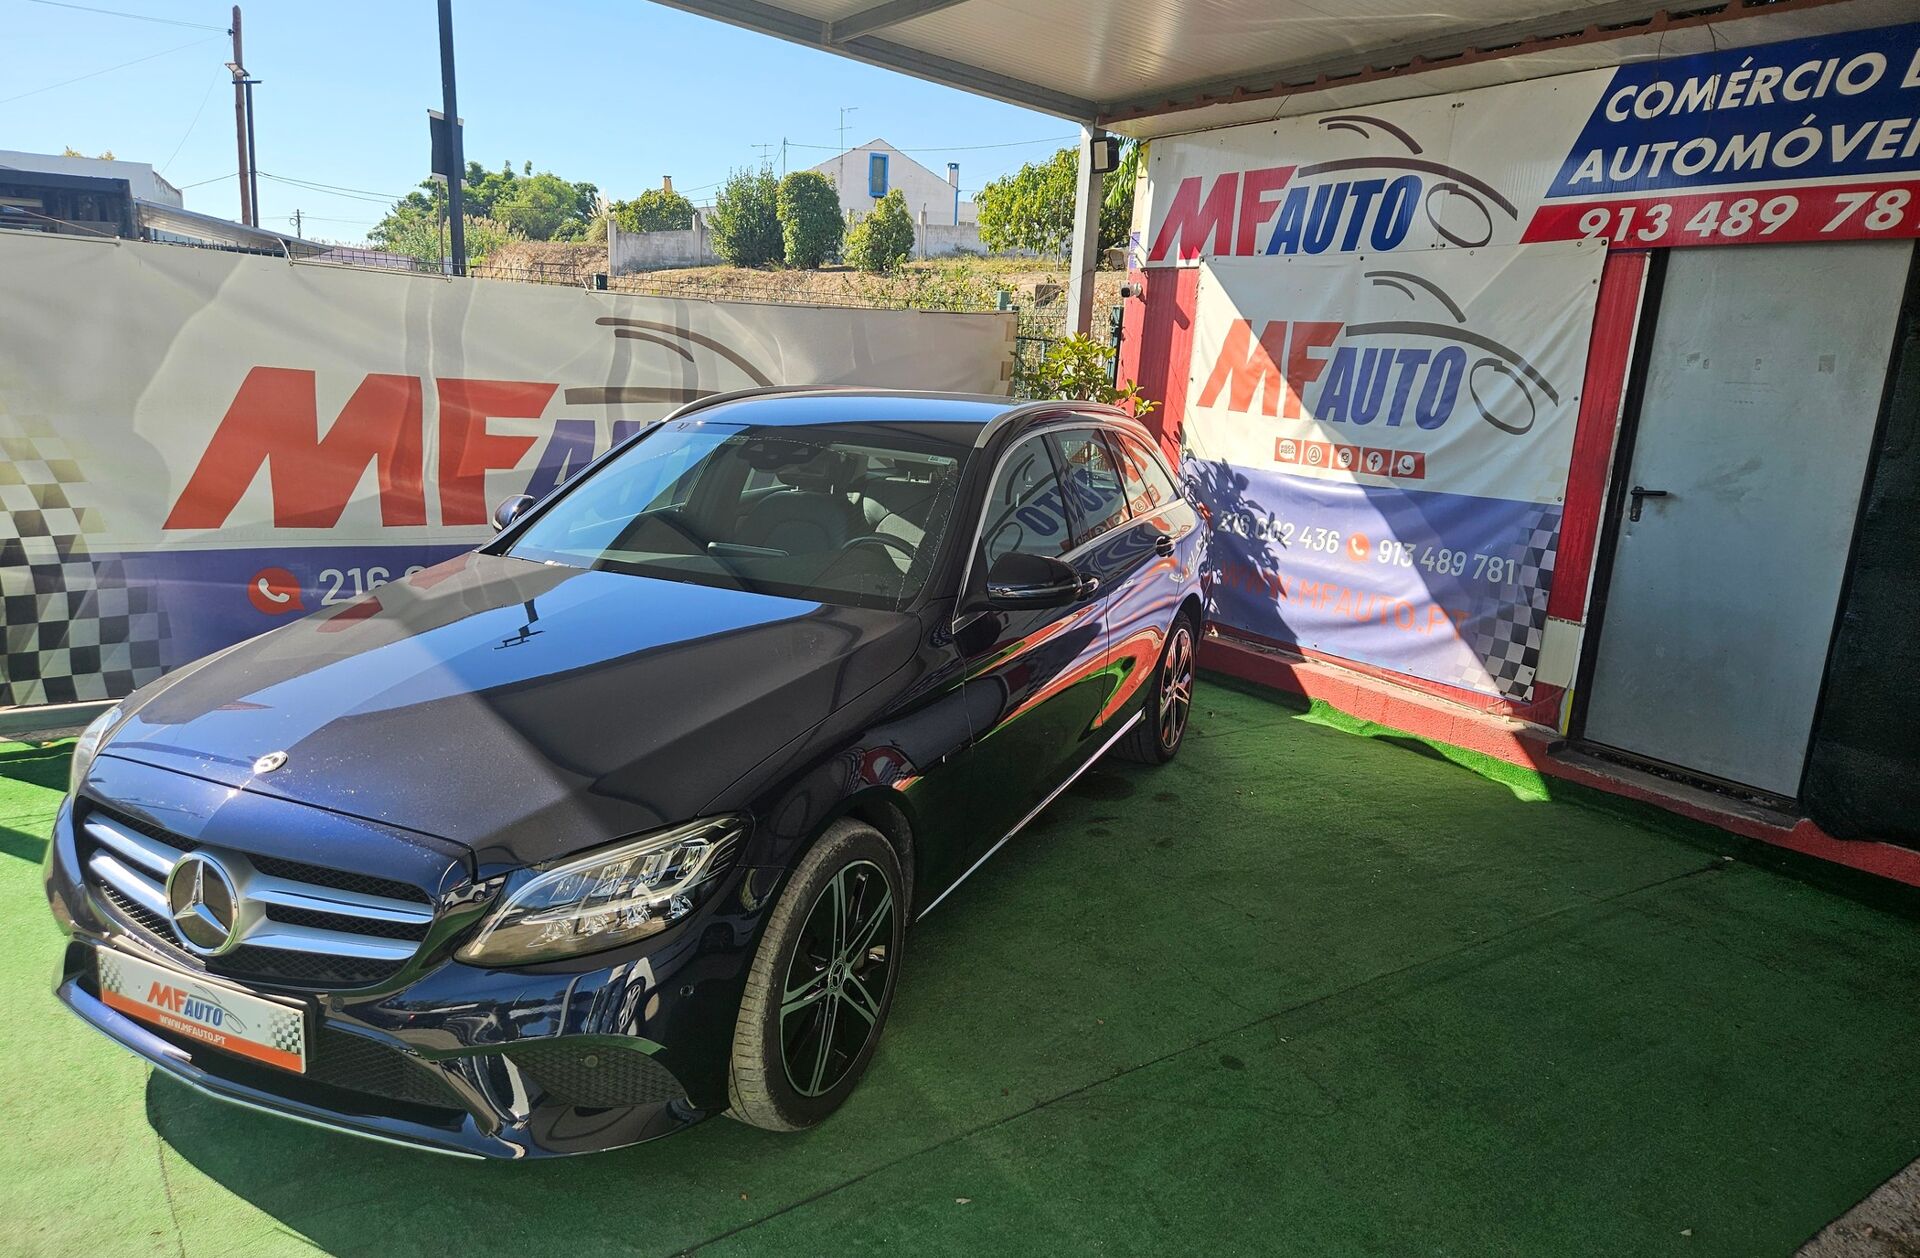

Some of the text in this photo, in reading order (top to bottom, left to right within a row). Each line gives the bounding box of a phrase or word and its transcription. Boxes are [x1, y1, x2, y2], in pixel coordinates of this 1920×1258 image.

[1605, 52, 1887, 122] COMÉRCIO
[1578, 188, 1920, 242] 913 489 78
[1299, 526, 1341, 553] 436
[1377, 539, 1417, 568] 913
[1420, 547, 1467, 577] 489
[1472, 553, 1515, 585] 781
[159, 1013, 226, 1046] WWW.MFAUTO.PT
